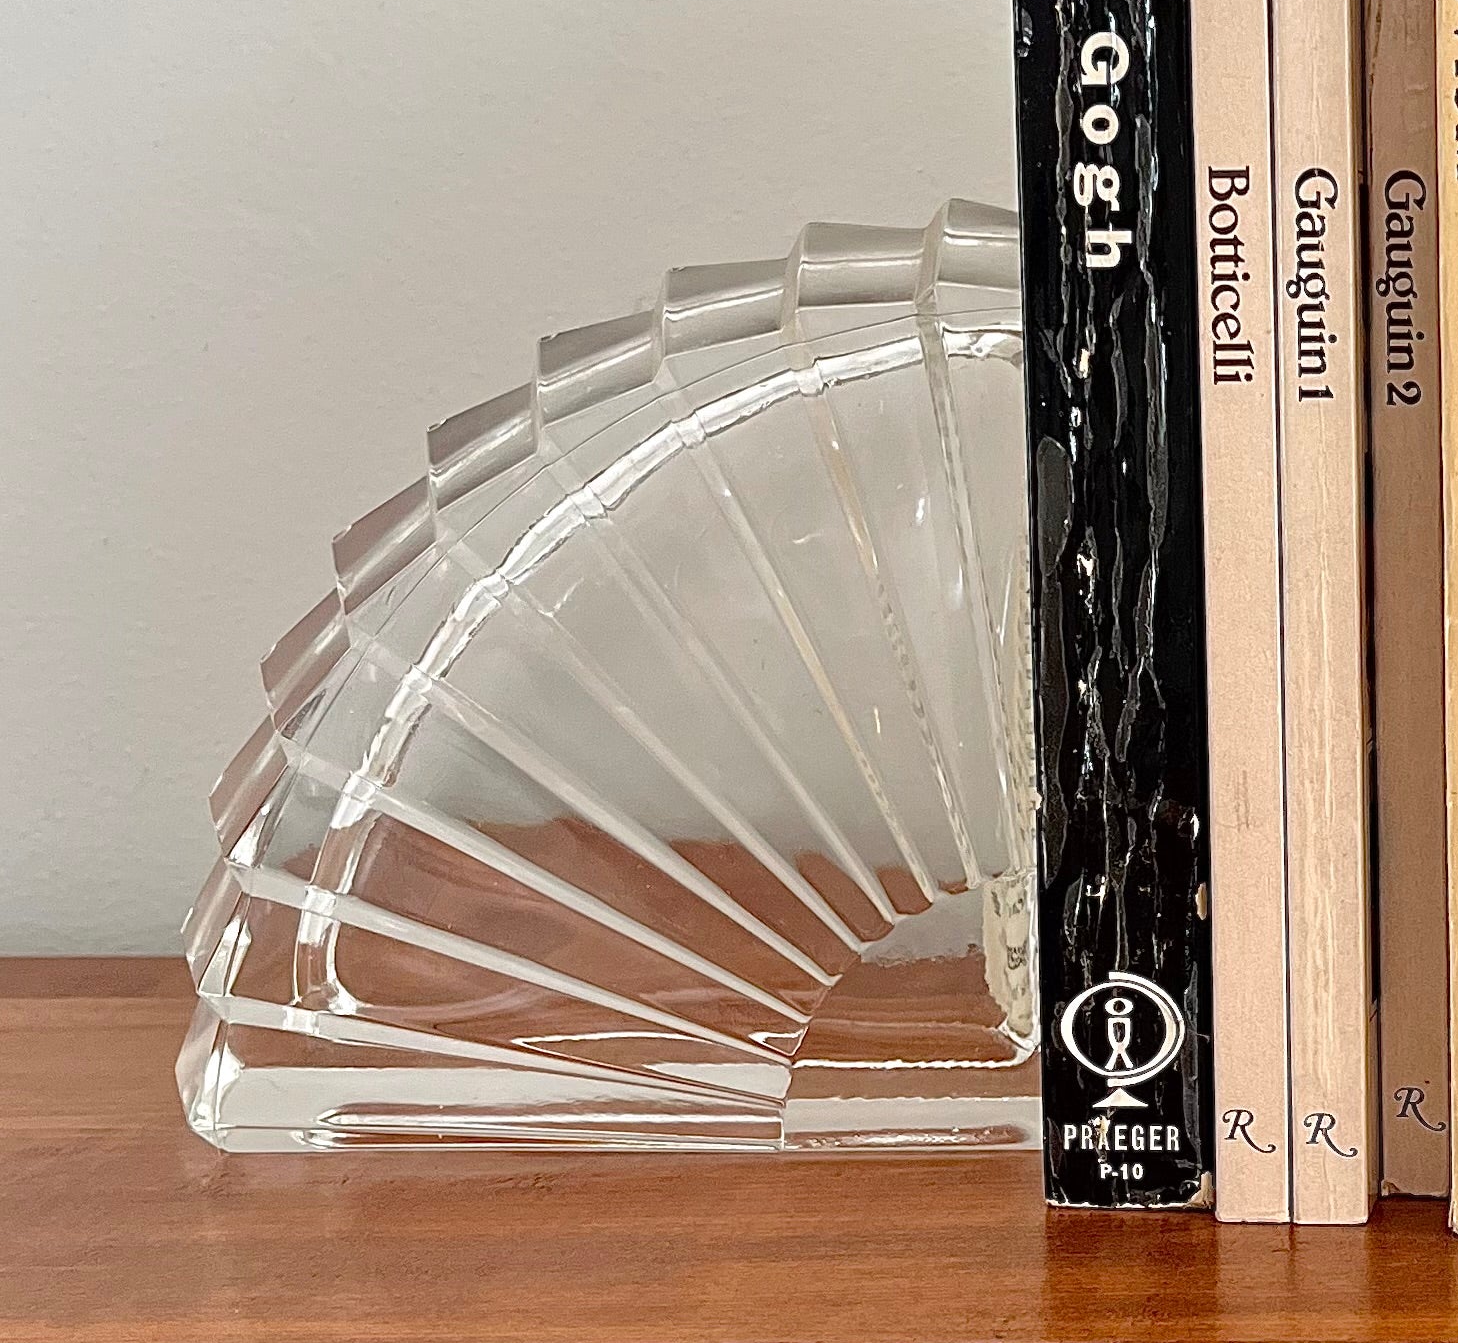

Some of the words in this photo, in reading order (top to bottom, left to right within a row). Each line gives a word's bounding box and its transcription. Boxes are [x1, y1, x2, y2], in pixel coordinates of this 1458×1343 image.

[1073, 31, 1133, 270] Gogh
[1208, 165, 1255, 385] Botticelli
[1285, 167, 1339, 378] Gauguin
[1375, 169, 1427, 374] Gauguin
[1298, 384, 1335, 403] 1
[1385, 380, 1422, 407] 2
[1222, 1109, 1277, 1154] R
[1393, 1086, 1447, 1132] R
[1063, 1124, 1180, 1152] PRAEGER
[1303, 1112, 1358, 1158] R
[1100, 1163, 1144, 1180] P-10
